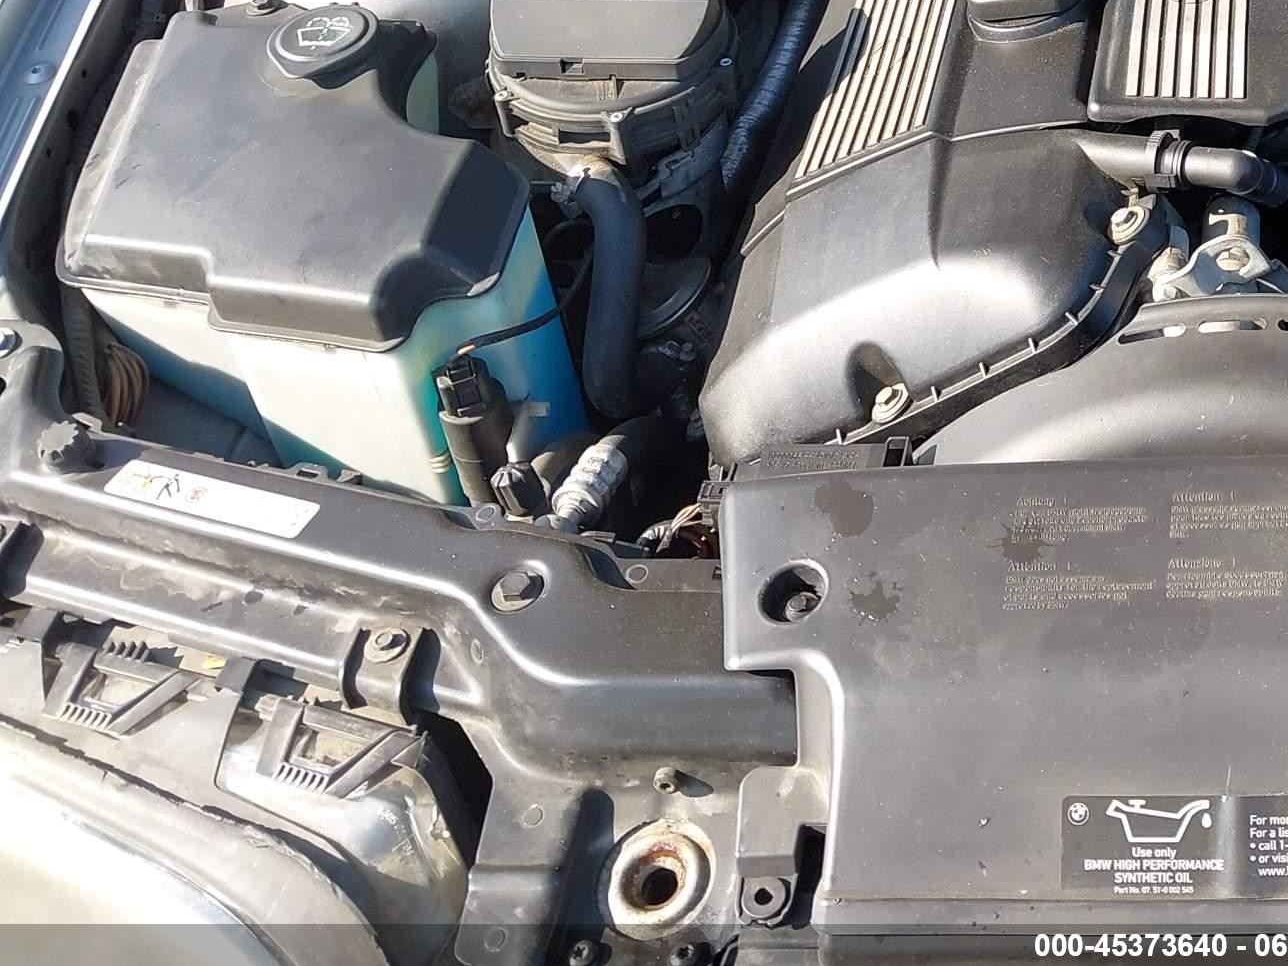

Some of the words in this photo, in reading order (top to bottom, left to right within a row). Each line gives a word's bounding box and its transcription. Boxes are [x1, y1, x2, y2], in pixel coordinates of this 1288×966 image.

[1172, 491, 1221, 502] Attention
[1250, 815, 1267, 825] For
[1250, 828, 1267, 838] For
[1269, 830, 1275, 838] a
[1258, 840, 1277, 850] call
[1132, 847, 1152, 857] Use
[1154, 847, 1177, 859] only
[1084, 860, 1112, 870] BMW
[1114, 860, 1140, 870] HIGH
[1143, 860, 1224, 870] PERFORMANCE
[1114, 872, 1174, 883] SYNTHETIC
[1175, 872, 1193, 883] OIL
